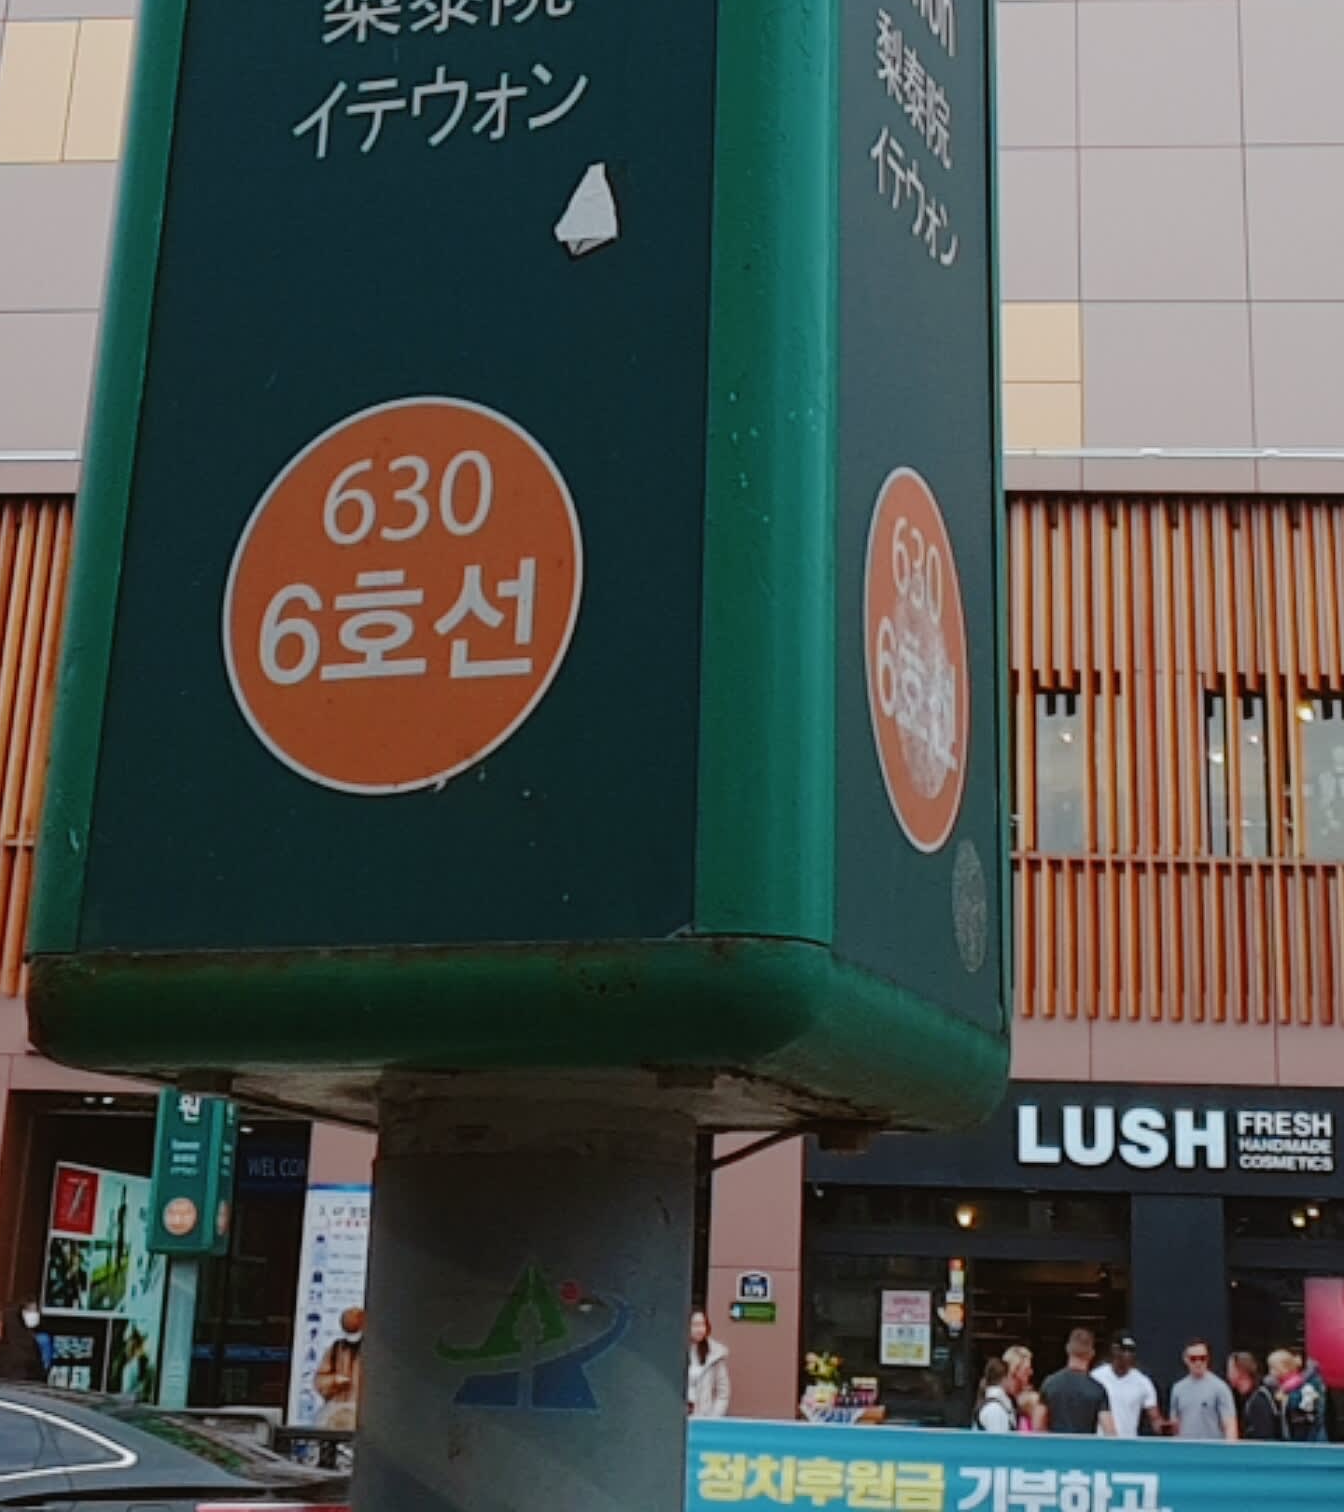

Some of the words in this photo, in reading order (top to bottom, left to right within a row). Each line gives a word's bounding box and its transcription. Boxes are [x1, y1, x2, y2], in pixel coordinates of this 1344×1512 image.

[292, 62, 590, 160] イテウォン
[876, 7, 952, 170] 梨泰院
[323, 448, 494, 546] 630
[891, 514, 943, 629] 630
[259, 557, 537, 685] 6호선
[1017, 1104, 1228, 1170] LUSH
[1237, 1110, 1333, 1137] FRESH
[1238, 1137, 1332, 1155] HANDMADE
[1238, 1154, 1334, 1172] COSMETICS
[697, 1451, 946, 1511] 정치후원금
